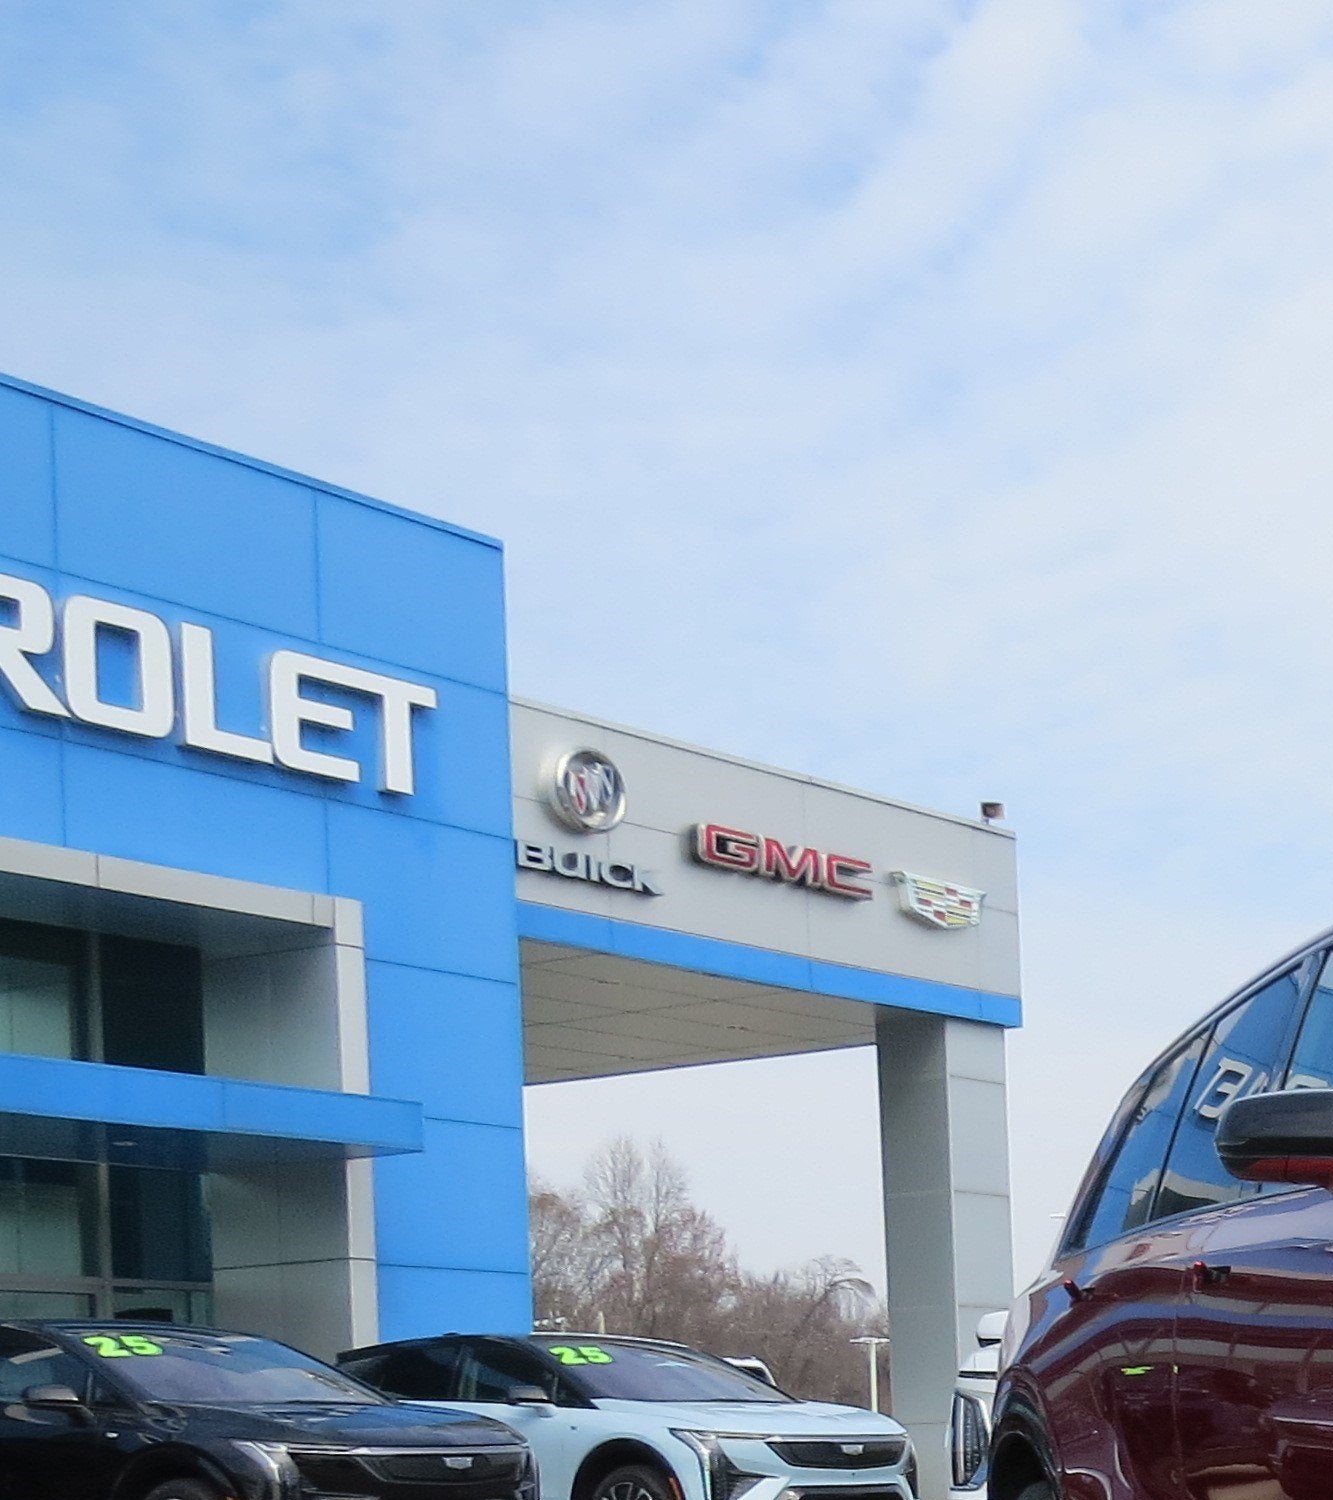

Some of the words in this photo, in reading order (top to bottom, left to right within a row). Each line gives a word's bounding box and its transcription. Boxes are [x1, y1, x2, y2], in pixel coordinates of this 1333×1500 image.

[516, 838, 663, 897] BUICK
[696, 823, 874, 901] GMC
[81, 1334, 164, 1358] 25
[547, 1345, 615, 1366] 25
